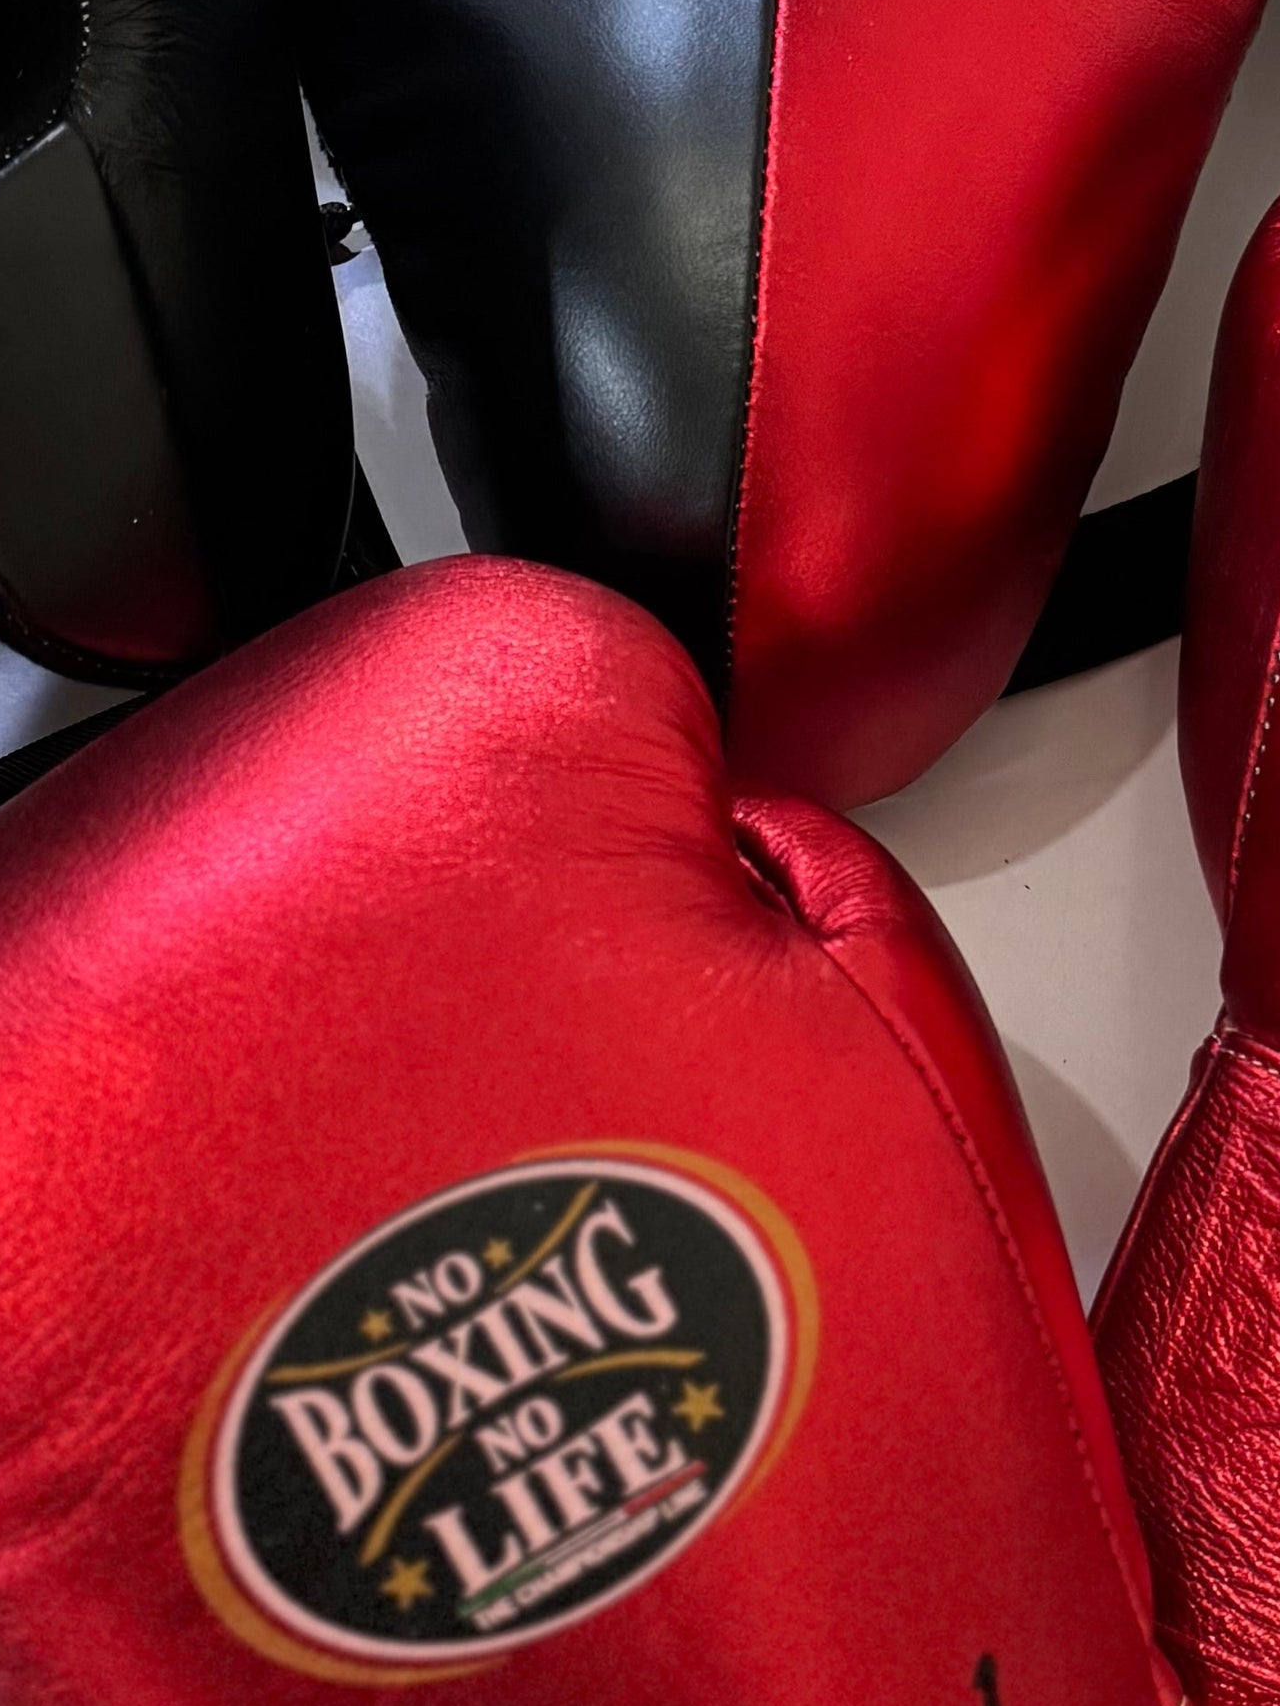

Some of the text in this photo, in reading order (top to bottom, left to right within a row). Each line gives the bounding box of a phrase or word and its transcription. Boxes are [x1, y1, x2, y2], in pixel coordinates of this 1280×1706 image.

[389, 1250, 482, 1330] NO
[269, 1199, 679, 1535] BOXING
[474, 1397, 564, 1474] NO
[423, 1391, 688, 1596] LIFE
